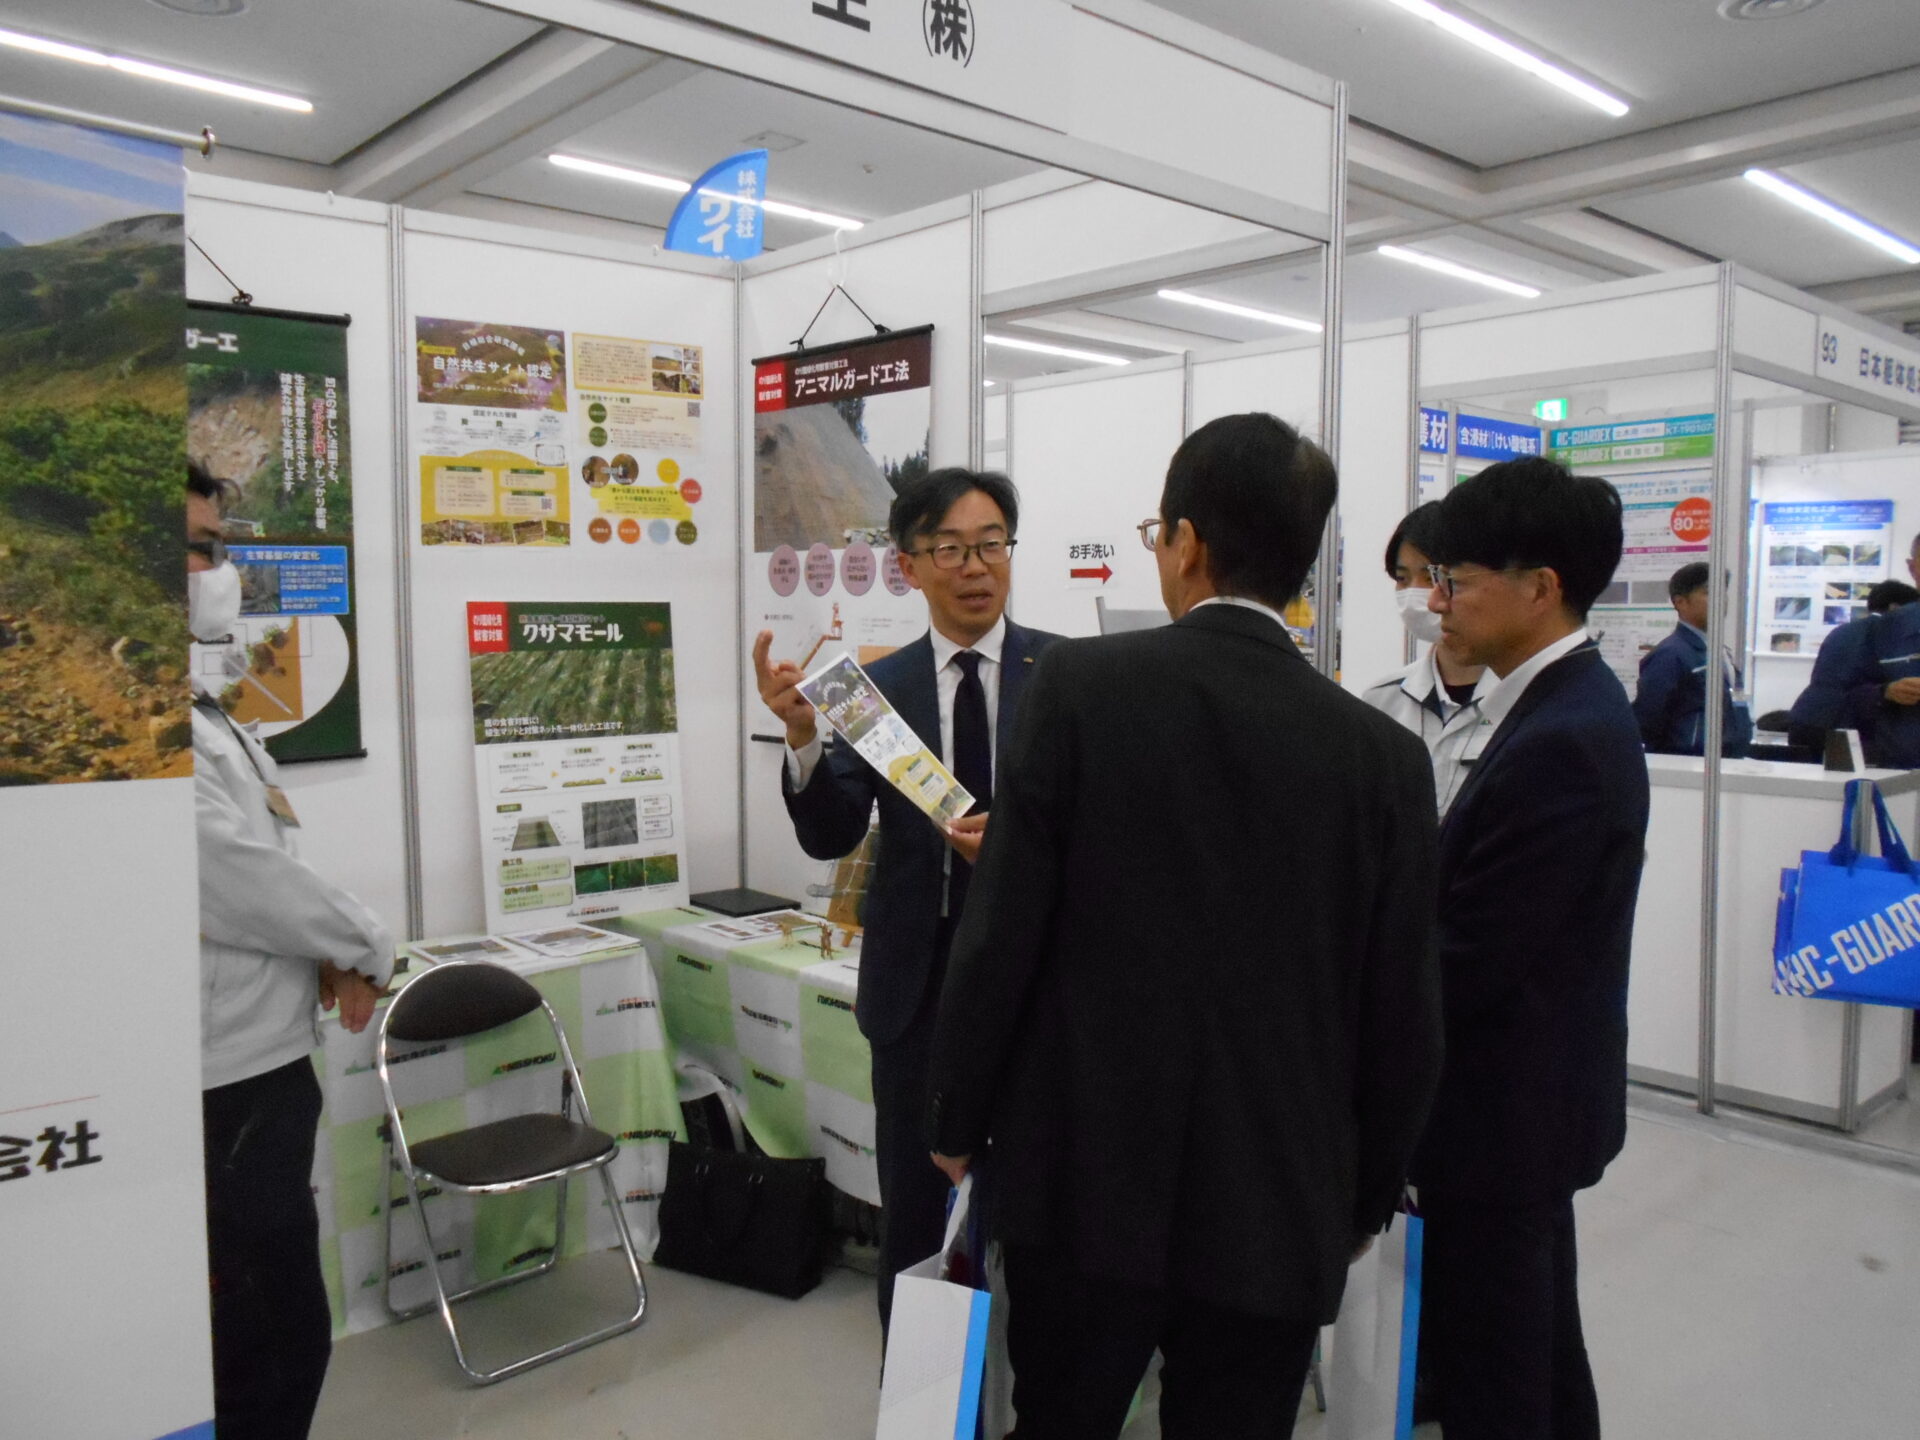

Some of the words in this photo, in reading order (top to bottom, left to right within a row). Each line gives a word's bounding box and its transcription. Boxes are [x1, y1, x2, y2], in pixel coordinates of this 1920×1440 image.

[697, 196, 732, 258] ワイ
[1822, 332, 1837, 364] 93
[433, 356, 553, 379] 自然共生サイト認定
[794, 359, 910, 398] アニマルガード工法
[1673, 516, 1694, 531] 80
[246, 551, 320, 561] 生育基盤の安定化
[1069, 543, 1115, 560] お手洗い
[522, 623, 625, 644] クサマモール
